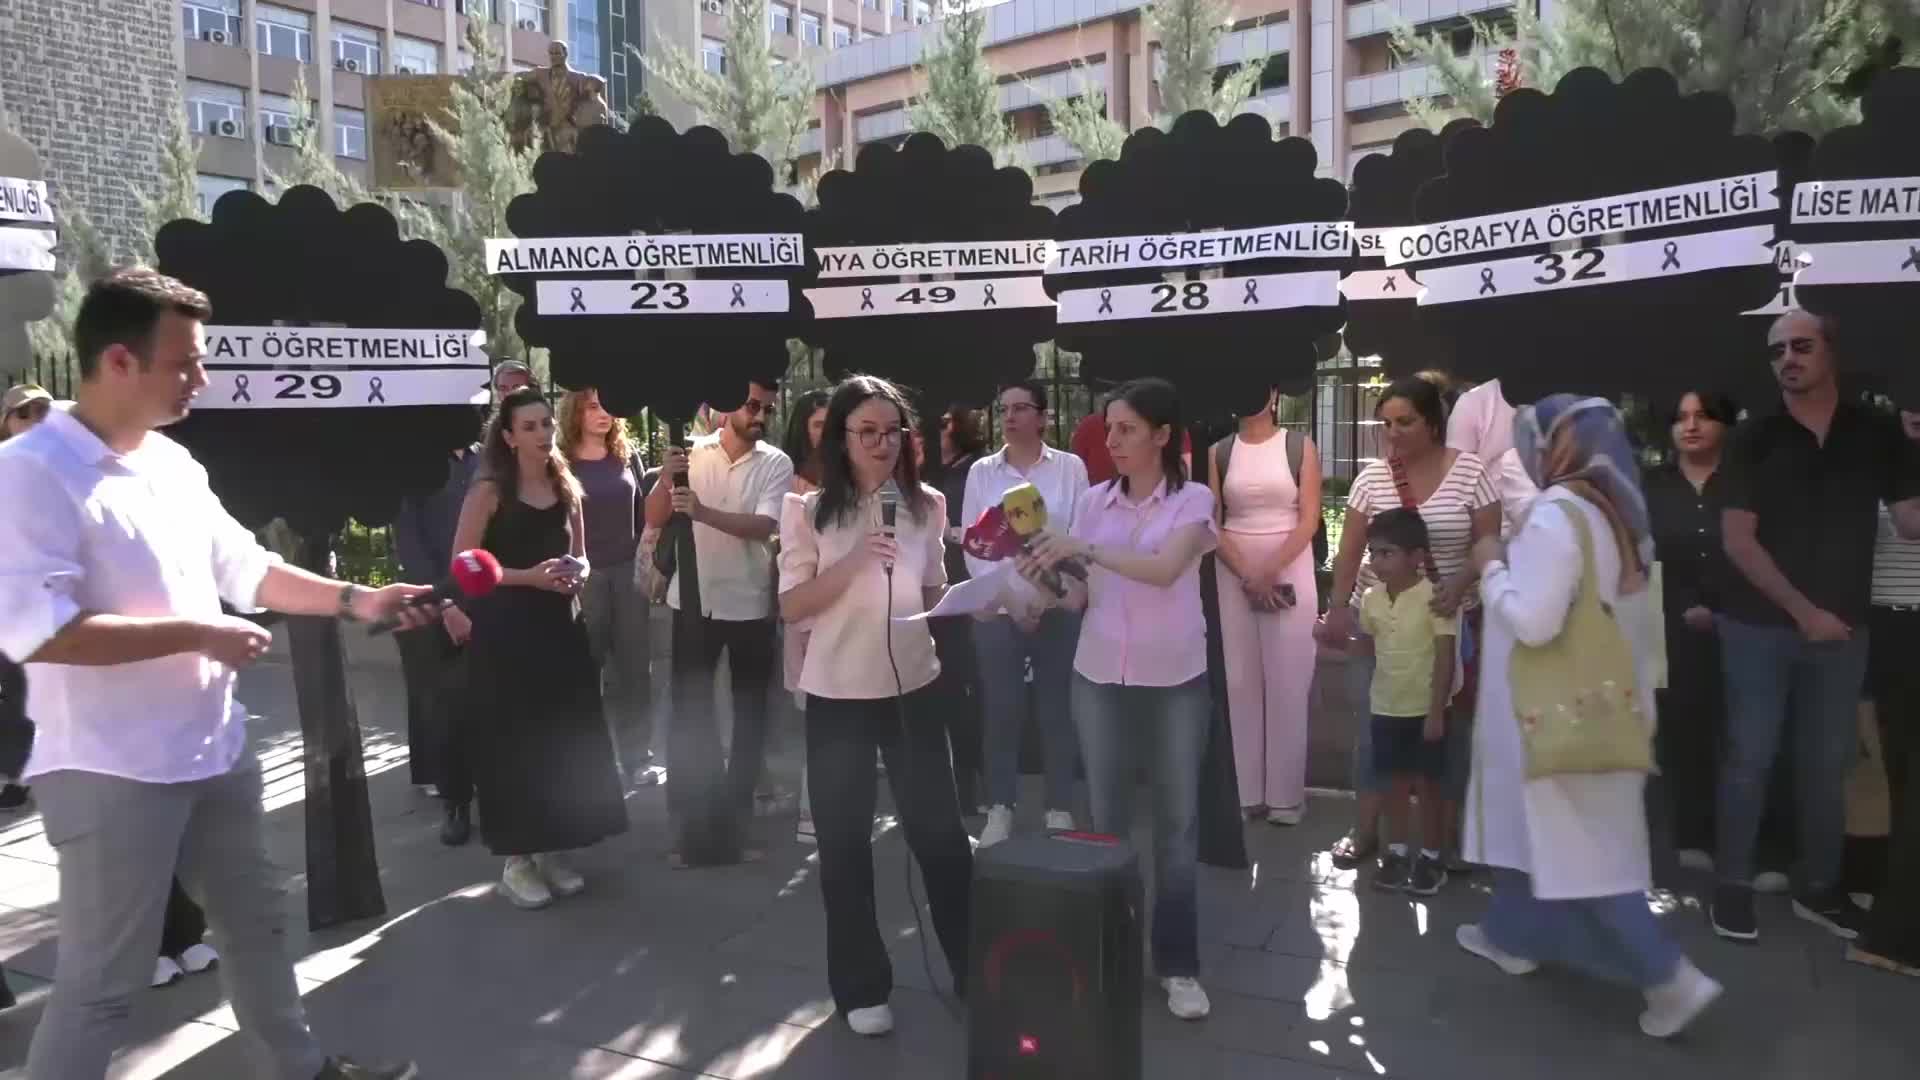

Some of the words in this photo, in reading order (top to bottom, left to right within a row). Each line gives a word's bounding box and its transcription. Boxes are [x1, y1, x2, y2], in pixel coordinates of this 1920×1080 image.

[1796, 185, 1853, 217] LİSE
[1860, 186, 1920, 214] MAT
[1399, 216, 1539, 259] COĞRAFYA
[1547, 178, 1759, 237] ÖĞRETMENLİĞİ
[497, 246, 618, 271] ALMANCA
[625, 237, 800, 267] ÖĞRETMENLİĞİ
[1056, 241, 1130, 267] TARİH
[1138, 224, 1349, 261] ÖĞRETMENLİĞİ
[1533, 248, 1607, 285] 32
[630, 282, 689, 310] 23
[895, 286, 956, 305] 49
[1150, 282, 1210, 313] 28
[263, 331, 470, 359] ÖĞRETMENLİĞİ
[273, 374, 342, 399] 29
